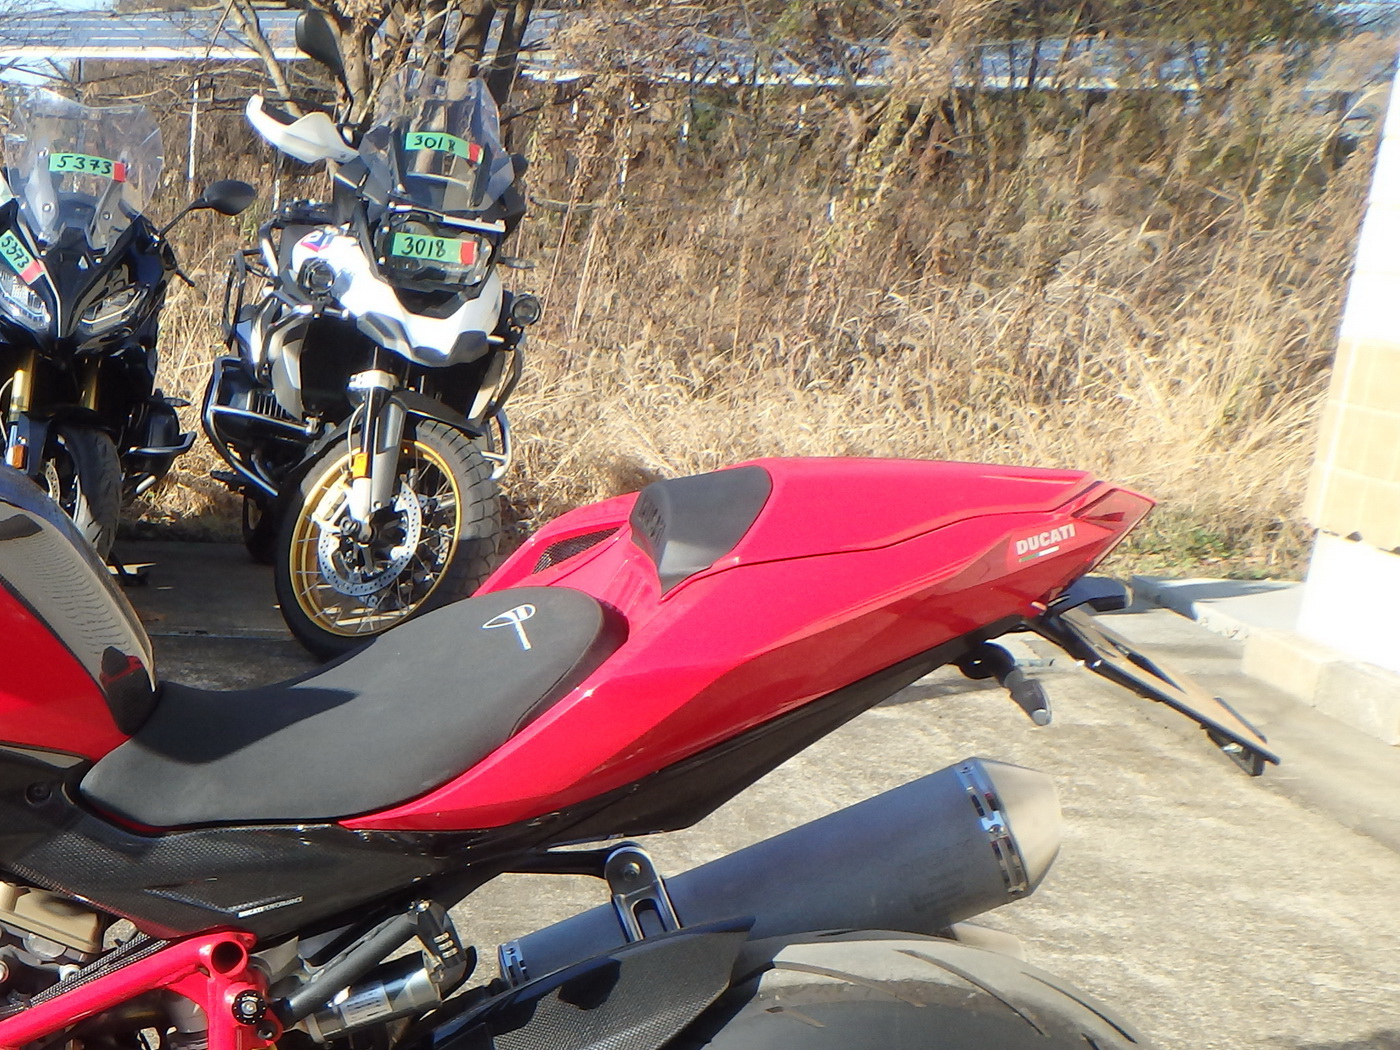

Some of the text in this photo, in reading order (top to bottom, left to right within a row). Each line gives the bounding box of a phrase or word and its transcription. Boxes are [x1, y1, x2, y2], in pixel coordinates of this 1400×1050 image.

[56, 155, 112, 175] 5373
[1, 234, 30, 269] 5373
[401, 236, 446, 258] 3018
[1015, 522, 1076, 555] DUCATI
